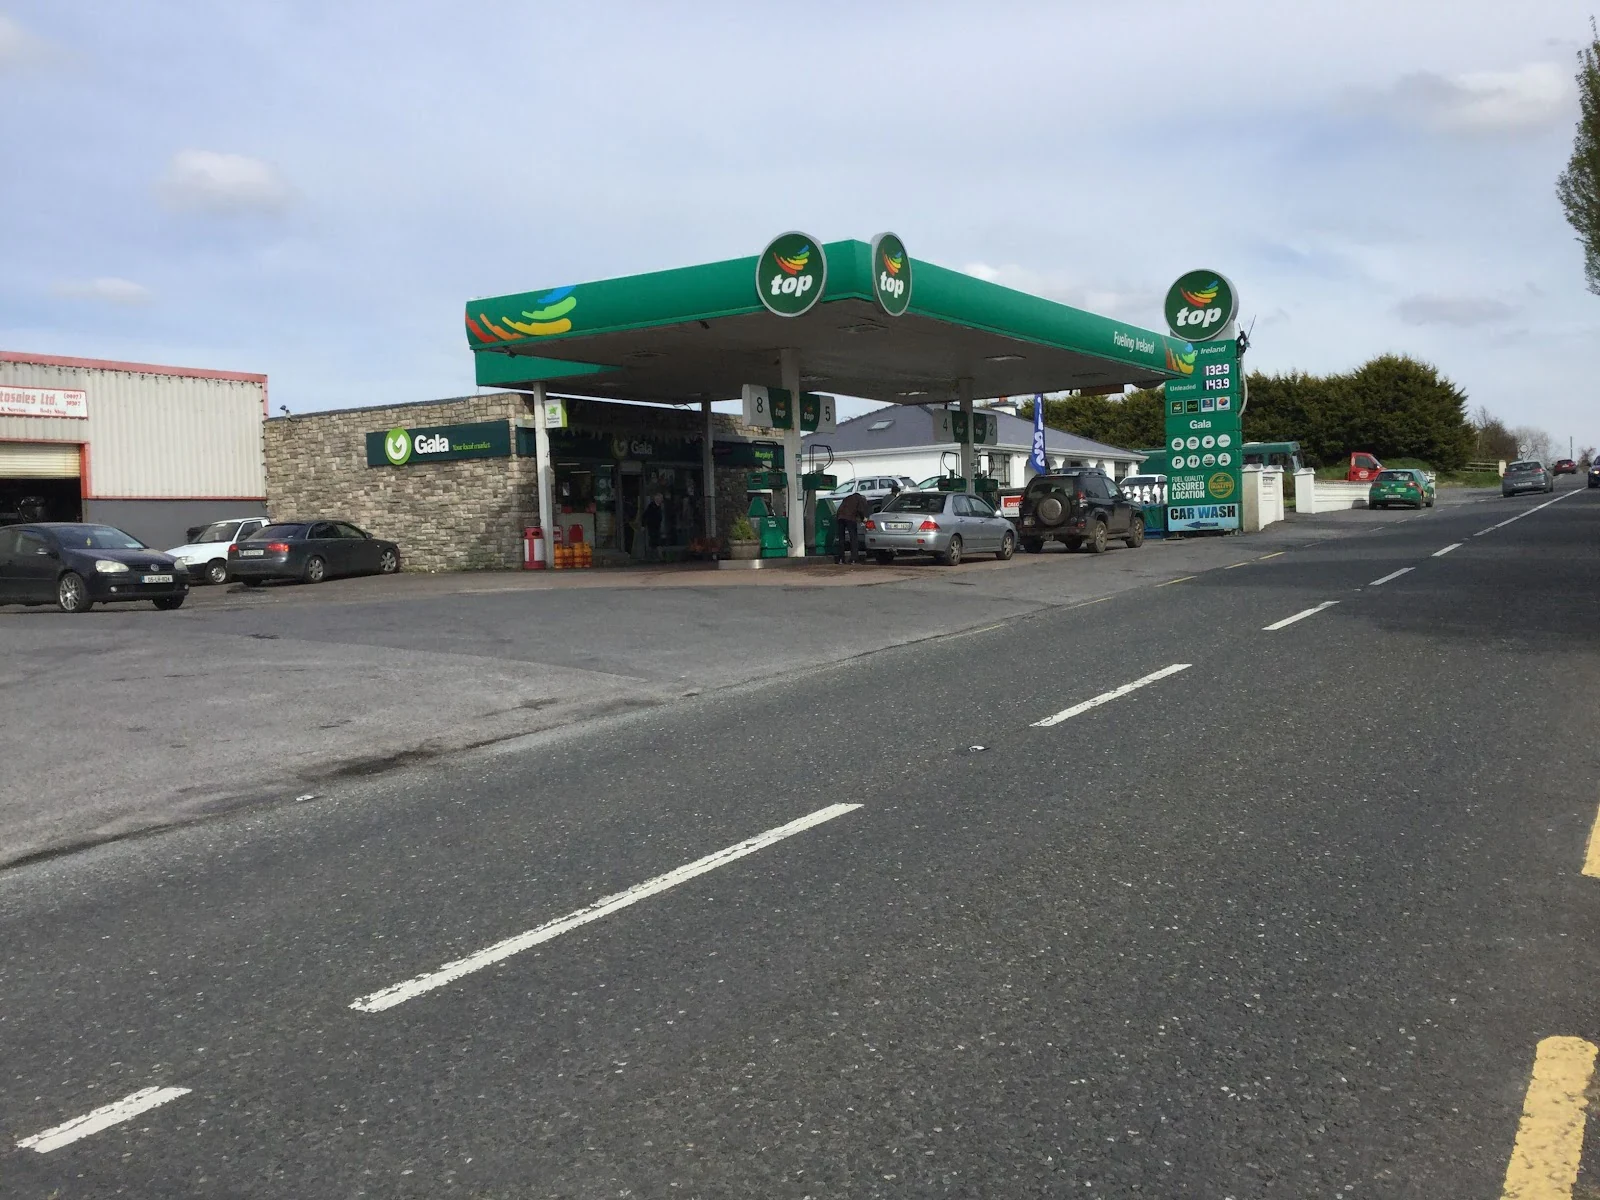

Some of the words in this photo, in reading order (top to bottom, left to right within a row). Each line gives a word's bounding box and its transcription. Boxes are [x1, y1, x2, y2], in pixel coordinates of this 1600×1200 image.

[770, 274, 813, 298] top
[880, 271, 904, 299] top
[1176, 306, 1222, 328] top
[1113, 331, 1135, 353] Fueling
[1135, 337, 1155, 355] Ireland
[1201, 345, 1226, 355] Ireland
[1205, 363, 1230, 376] 132.9
[1169, 384, 1196, 392] Unleaded
[1205, 378, 1230, 391] 143.9
[40, 393, 58, 406] Ltd.
[756, 396, 763, 414] 8
[803, 411, 815, 421] top
[825, 405, 831, 422] 5
[942, 418, 948, 432] 4
[989, 422, 994, 437] 2
[1189, 420, 1211, 430] Gala
[414, 433, 450, 455] Gala
[630, 440, 653, 455] Gala
[1175, 458, 1182, 467] P
[1171, 475, 1183, 483] FUEL
[1184, 474, 1205, 483] QUALITY
[1172, 481, 1205, 492] ASSURED
[1171, 489, 1205, 500] LOCATION
[1170, 507, 1195, 521] CAR
[1197, 505, 1236, 519] WASH
